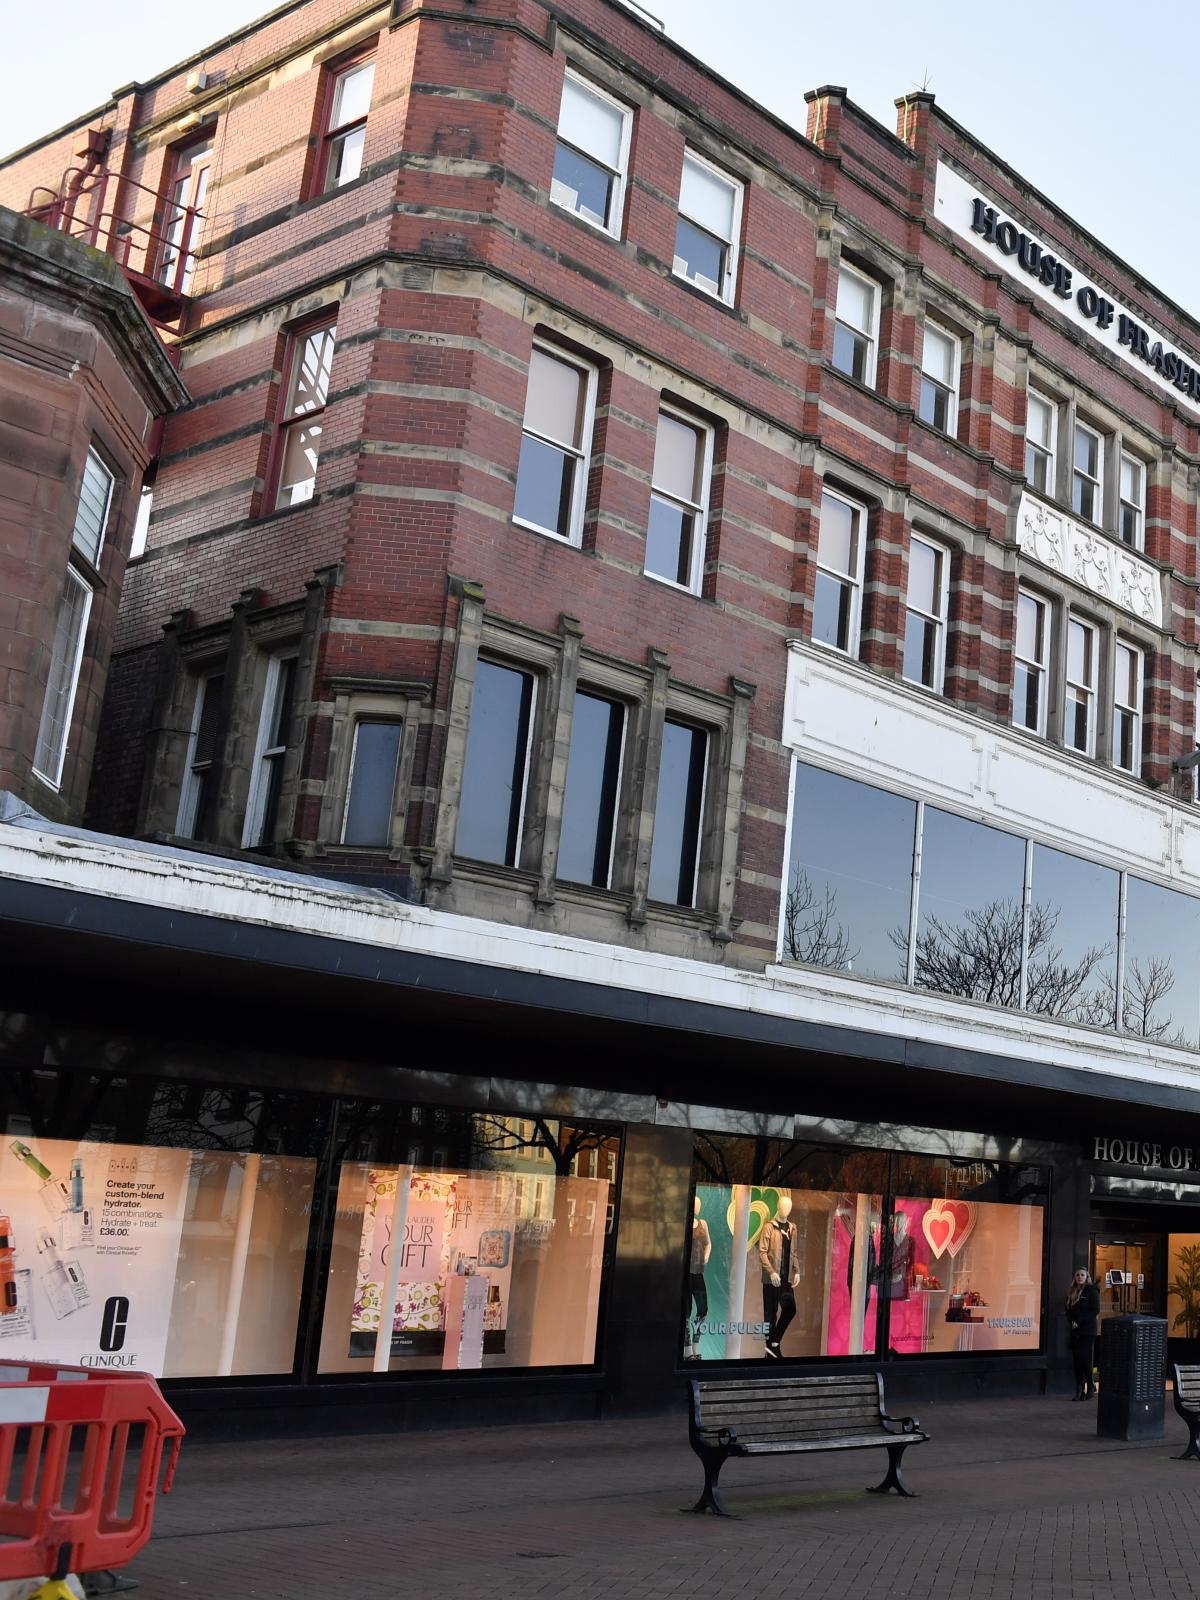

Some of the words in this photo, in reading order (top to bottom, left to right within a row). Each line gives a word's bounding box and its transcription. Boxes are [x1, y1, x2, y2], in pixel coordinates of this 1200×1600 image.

[969, 197, 1073, 300] HOUSE
[1077, 286, 1114, 330] OF
[1093, 1136, 1162, 1167] HOUSE
[1169, 1145, 1193, 1169] OF
[106, 1180, 135, 1189] Create
[105, 1190, 165, 1200] custom-blend
[103, 1199, 142, 1208] hydrator.
[102, 1209, 111, 1217] 15
[111, 1209, 164, 1218] combinations.
[100, 1219, 131, 1228] Hydrate
[987, 1317, 1032, 1328] THURSDAY
[692, 1321, 728, 1335] YOUR
[730, 1321, 770, 1335] PULSE
[80, 1355, 137, 1368] CLINIQUE
